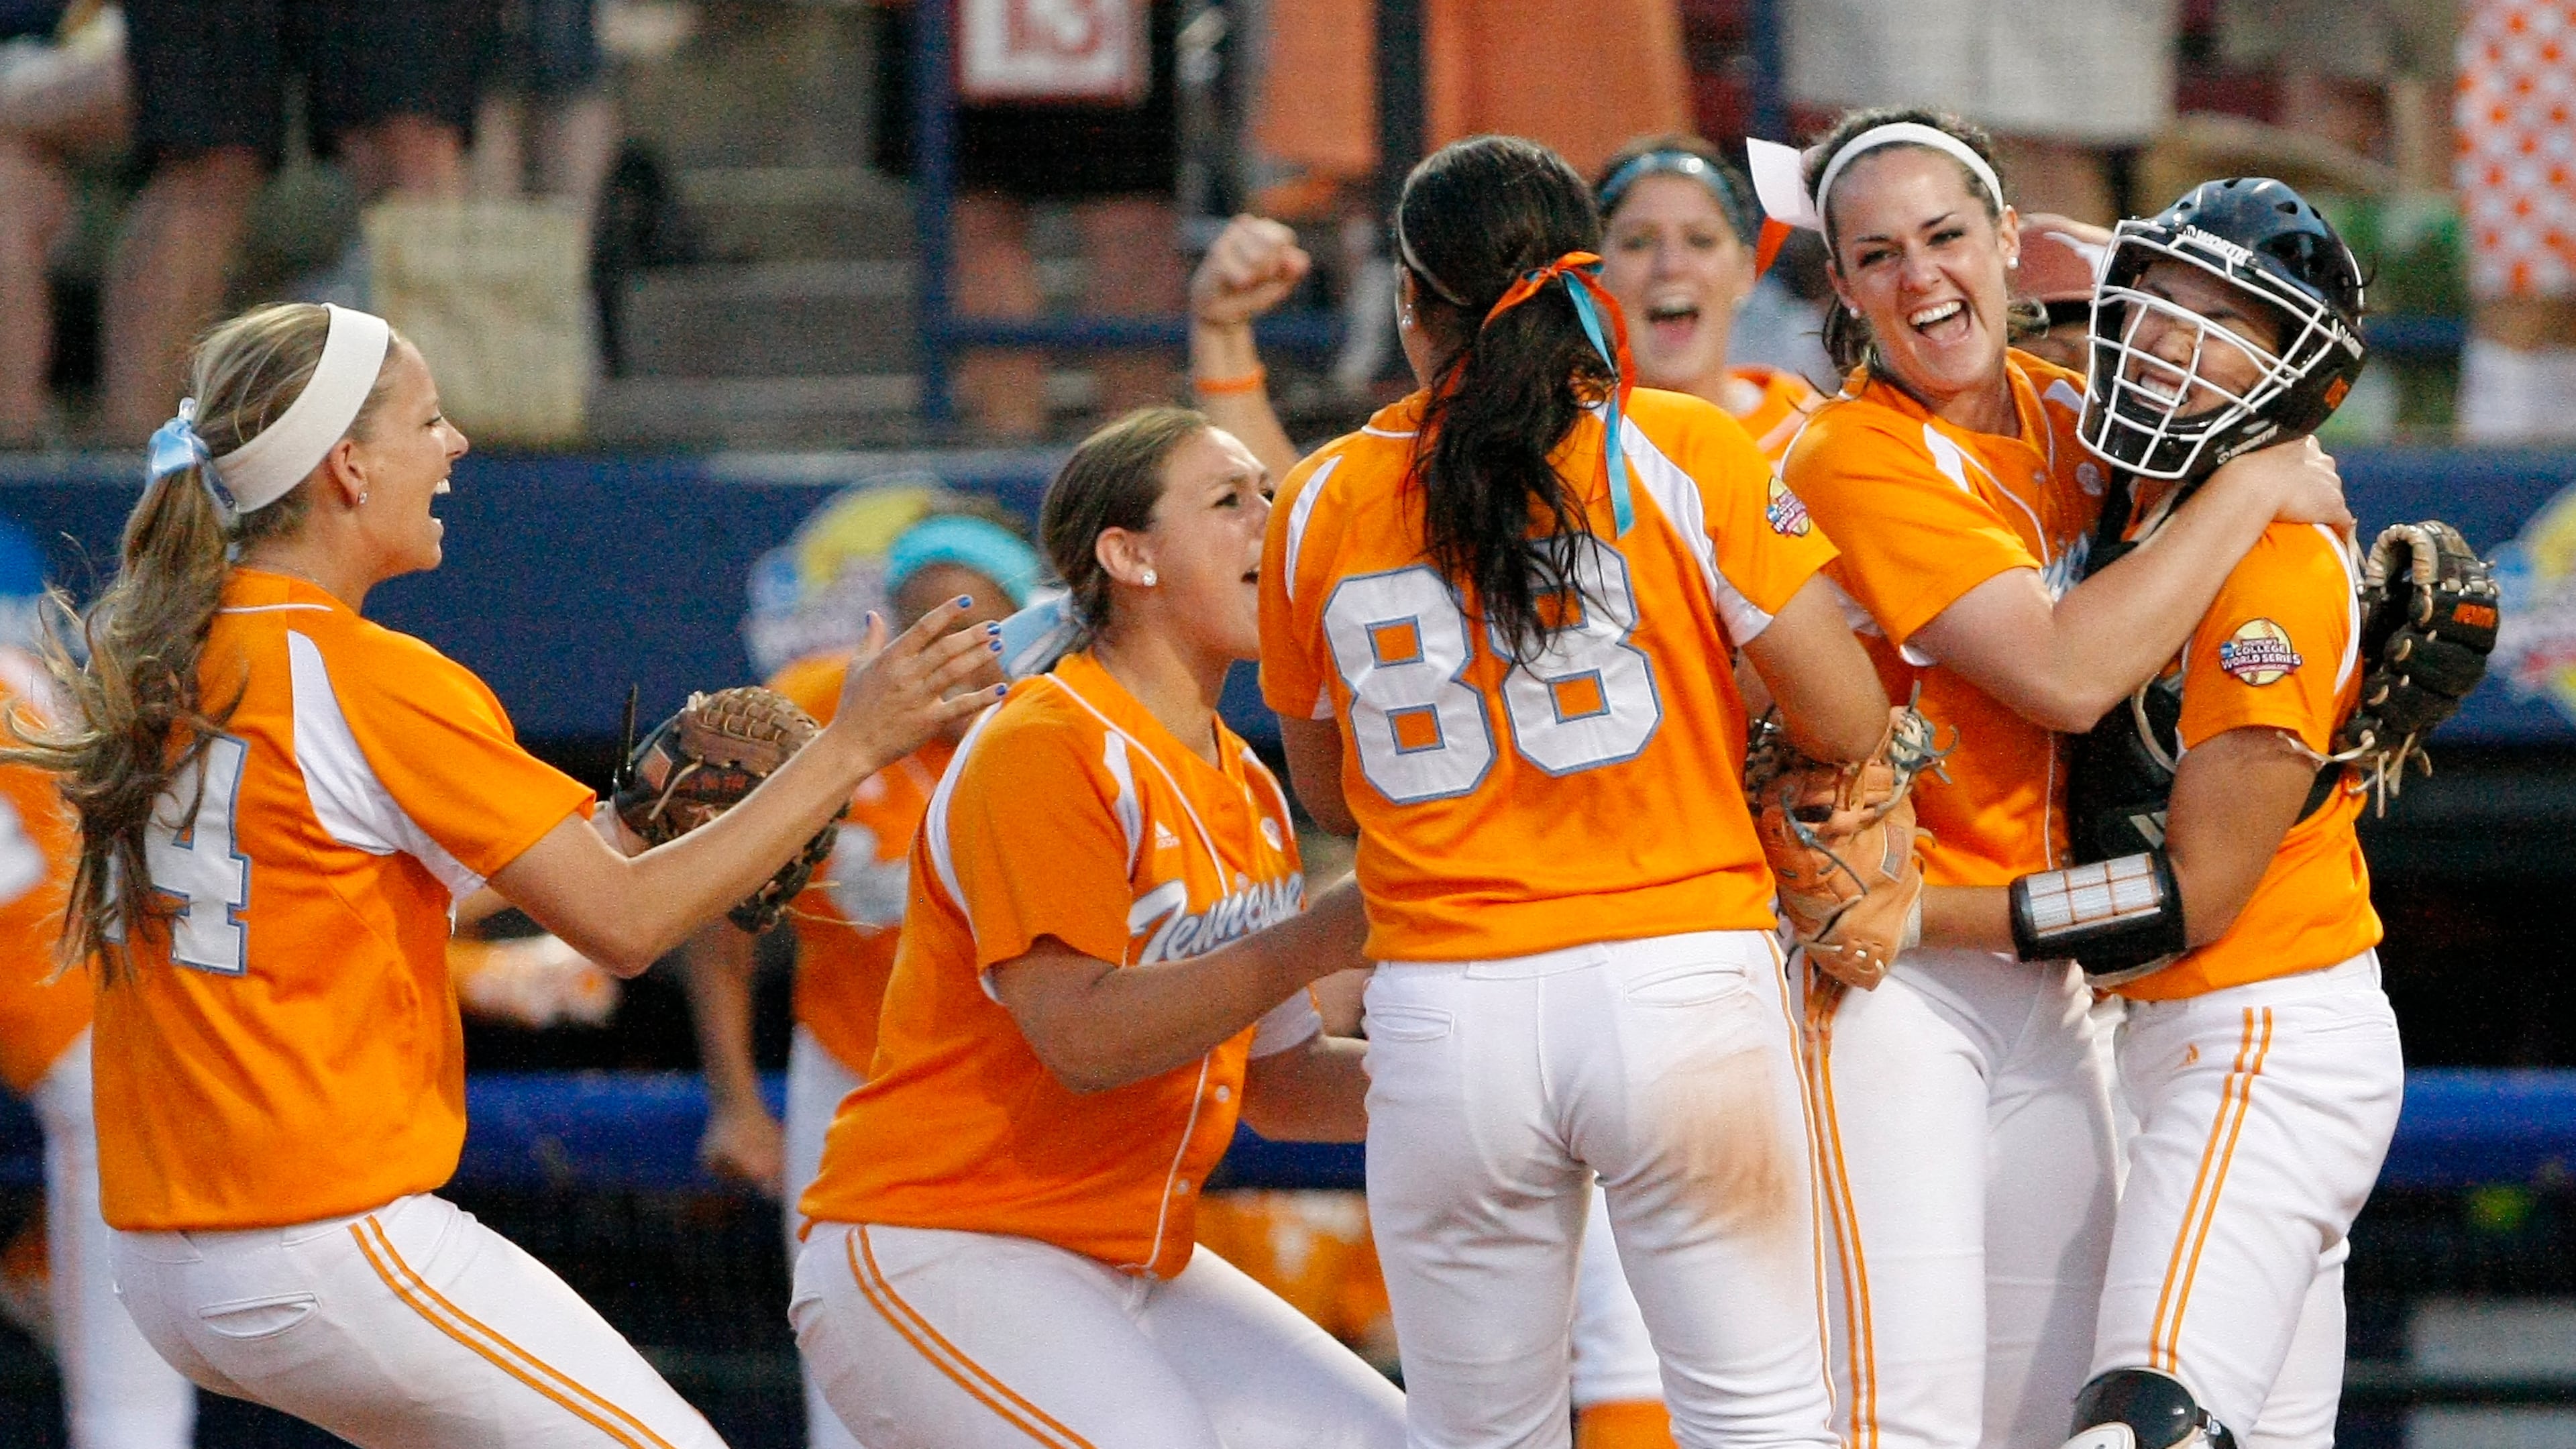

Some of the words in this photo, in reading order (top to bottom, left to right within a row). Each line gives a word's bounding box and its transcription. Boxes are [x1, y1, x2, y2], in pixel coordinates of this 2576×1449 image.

[1323, 532, 1664, 805] 88
[2220, 655, 2261, 670] WORLD
[2261, 653, 2302, 665] SERIES
[2235, 642, 2287, 657] COLLEGE
[99, 732, 251, 977] 4
